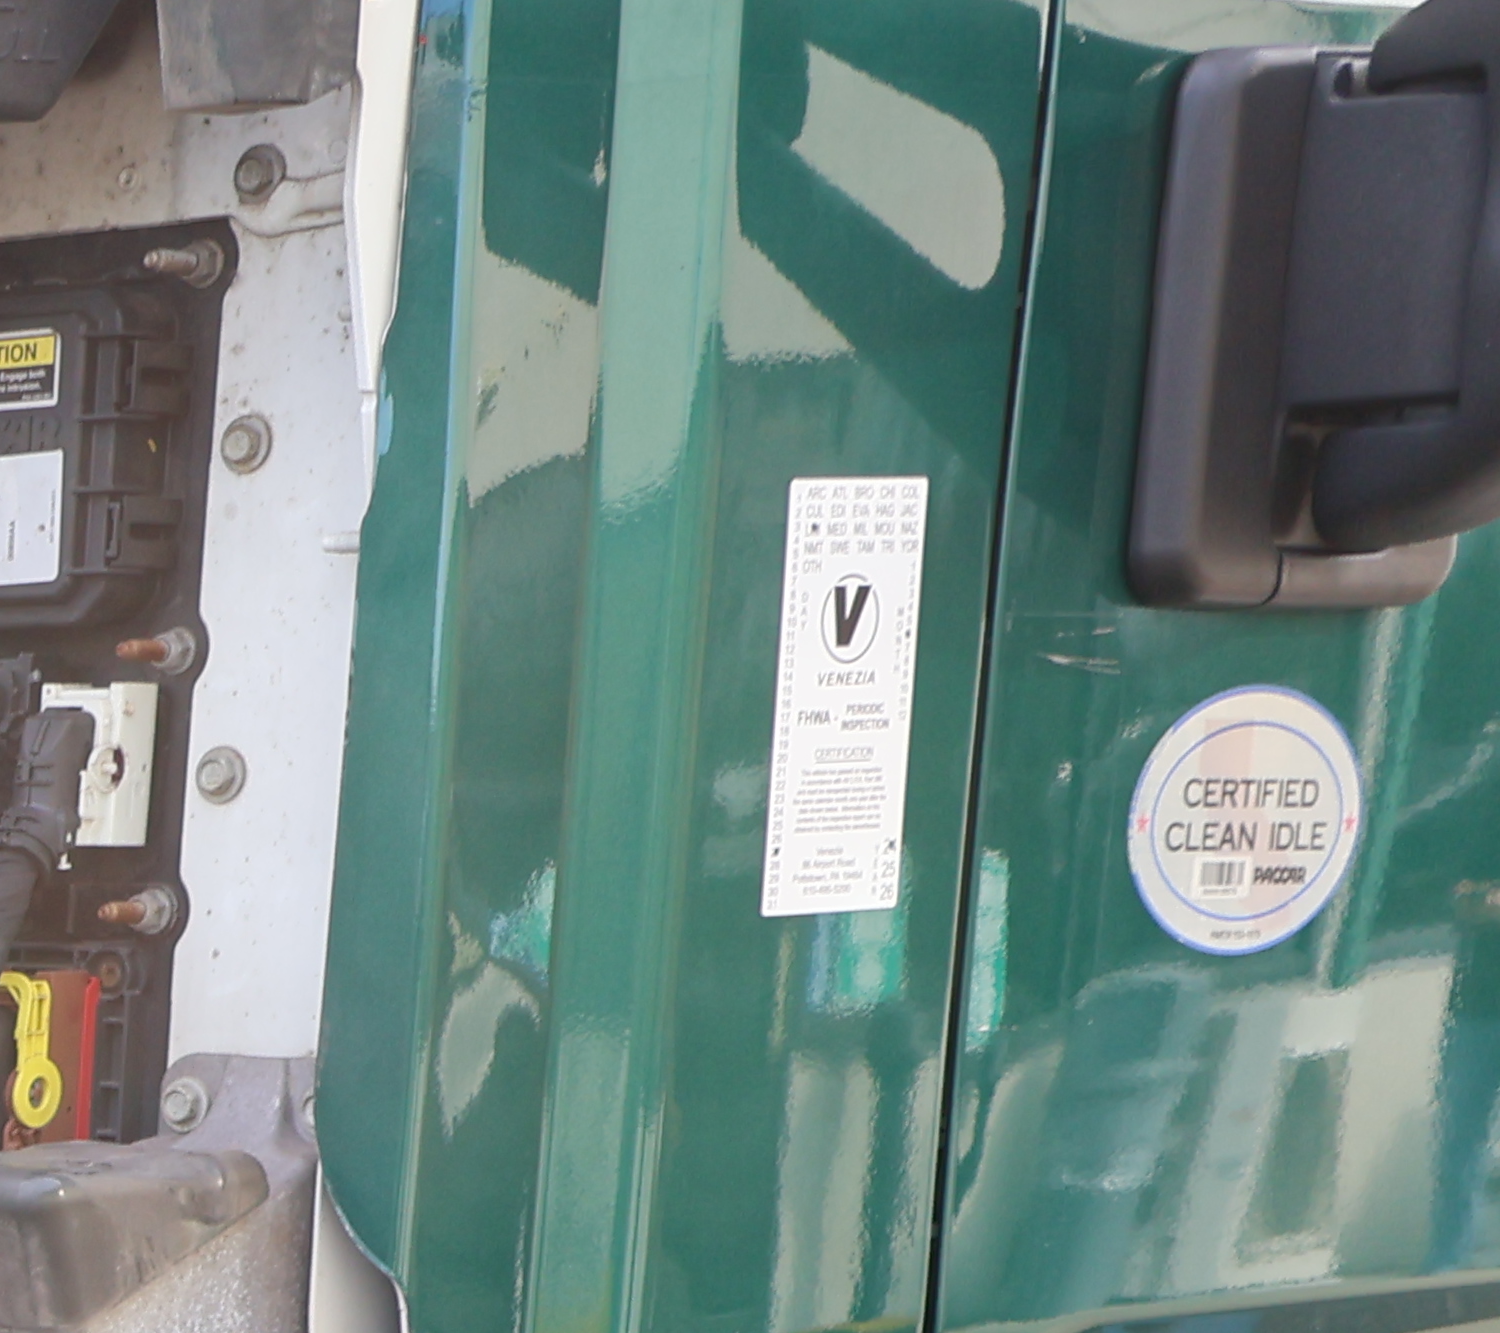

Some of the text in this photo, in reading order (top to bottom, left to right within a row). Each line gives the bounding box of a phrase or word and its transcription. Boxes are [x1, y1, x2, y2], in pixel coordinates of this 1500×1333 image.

[834, 584, 872, 648] V
[817, 670, 876, 687] VENEZIA
[797, 710, 831, 726] FHWA
[840, 718, 890, 731] INSPECTION
[1183, 778, 1320, 809] CERTIFIED
[1164, 821, 1328, 852] CLEAN IDLE
[881, 860, 896, 878] 25
[1253, 866, 1307, 886] PACCAR
[879, 883, 895, 901] 26
